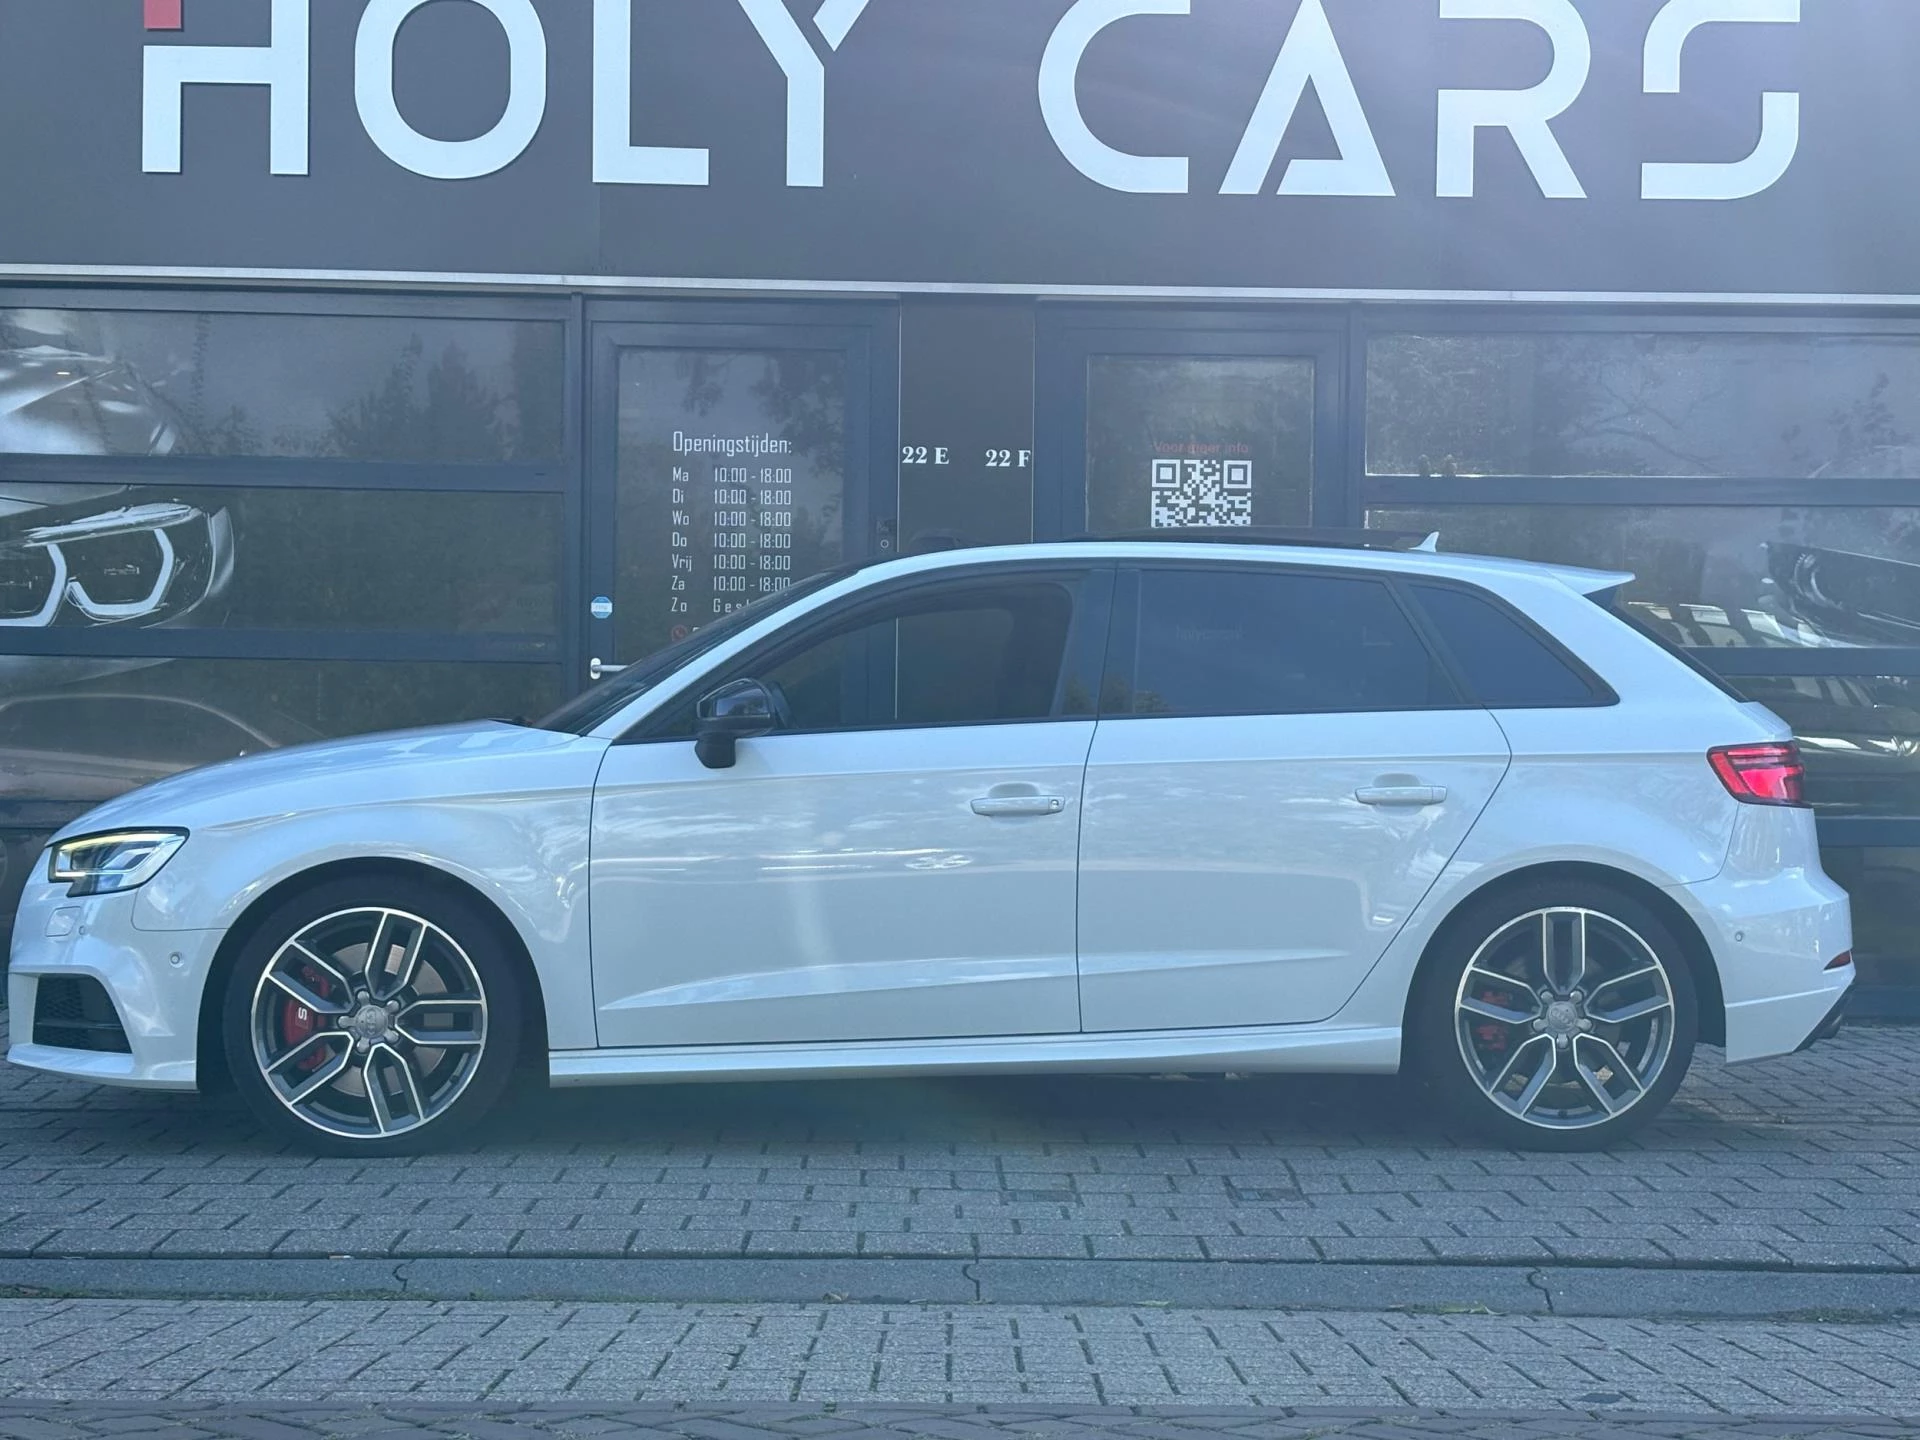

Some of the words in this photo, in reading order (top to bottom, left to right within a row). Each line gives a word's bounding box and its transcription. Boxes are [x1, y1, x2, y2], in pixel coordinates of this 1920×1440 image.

[142, 0, 870, 188] HOLY
[1037, 0, 1801, 201] CARS
[673, 431, 792, 458] Openingstijden:
[902, 446, 928, 464] 22
[934, 447, 949, 465] E
[985, 449, 1011, 467] 22
[1018, 450, 1032, 468] F
[672, 466, 689, 482] Ma
[714, 467, 747, 482] 10:00
[761, 468, 792, 483] 18:00
[672, 488, 684, 504] Di
[714, 489, 747, 504] 10:00
[761, 490, 792, 505] 18:00
[672, 510, 690, 526] Wo
[714, 511, 747, 526] 10:00
[761, 512, 792, 527] 18:00
[672, 532, 687, 547] Do
[713, 533, 746, 548] 10:00
[760, 534, 791, 549] 18:00
[671, 553, 692, 572] Vrij
[713, 554, 746, 569] 10:00
[760, 555, 791, 570] 18:00
[671, 575, 685, 591] Za
[713, 576, 746, 591] 10:00
[671, 597, 687, 612] Zo
